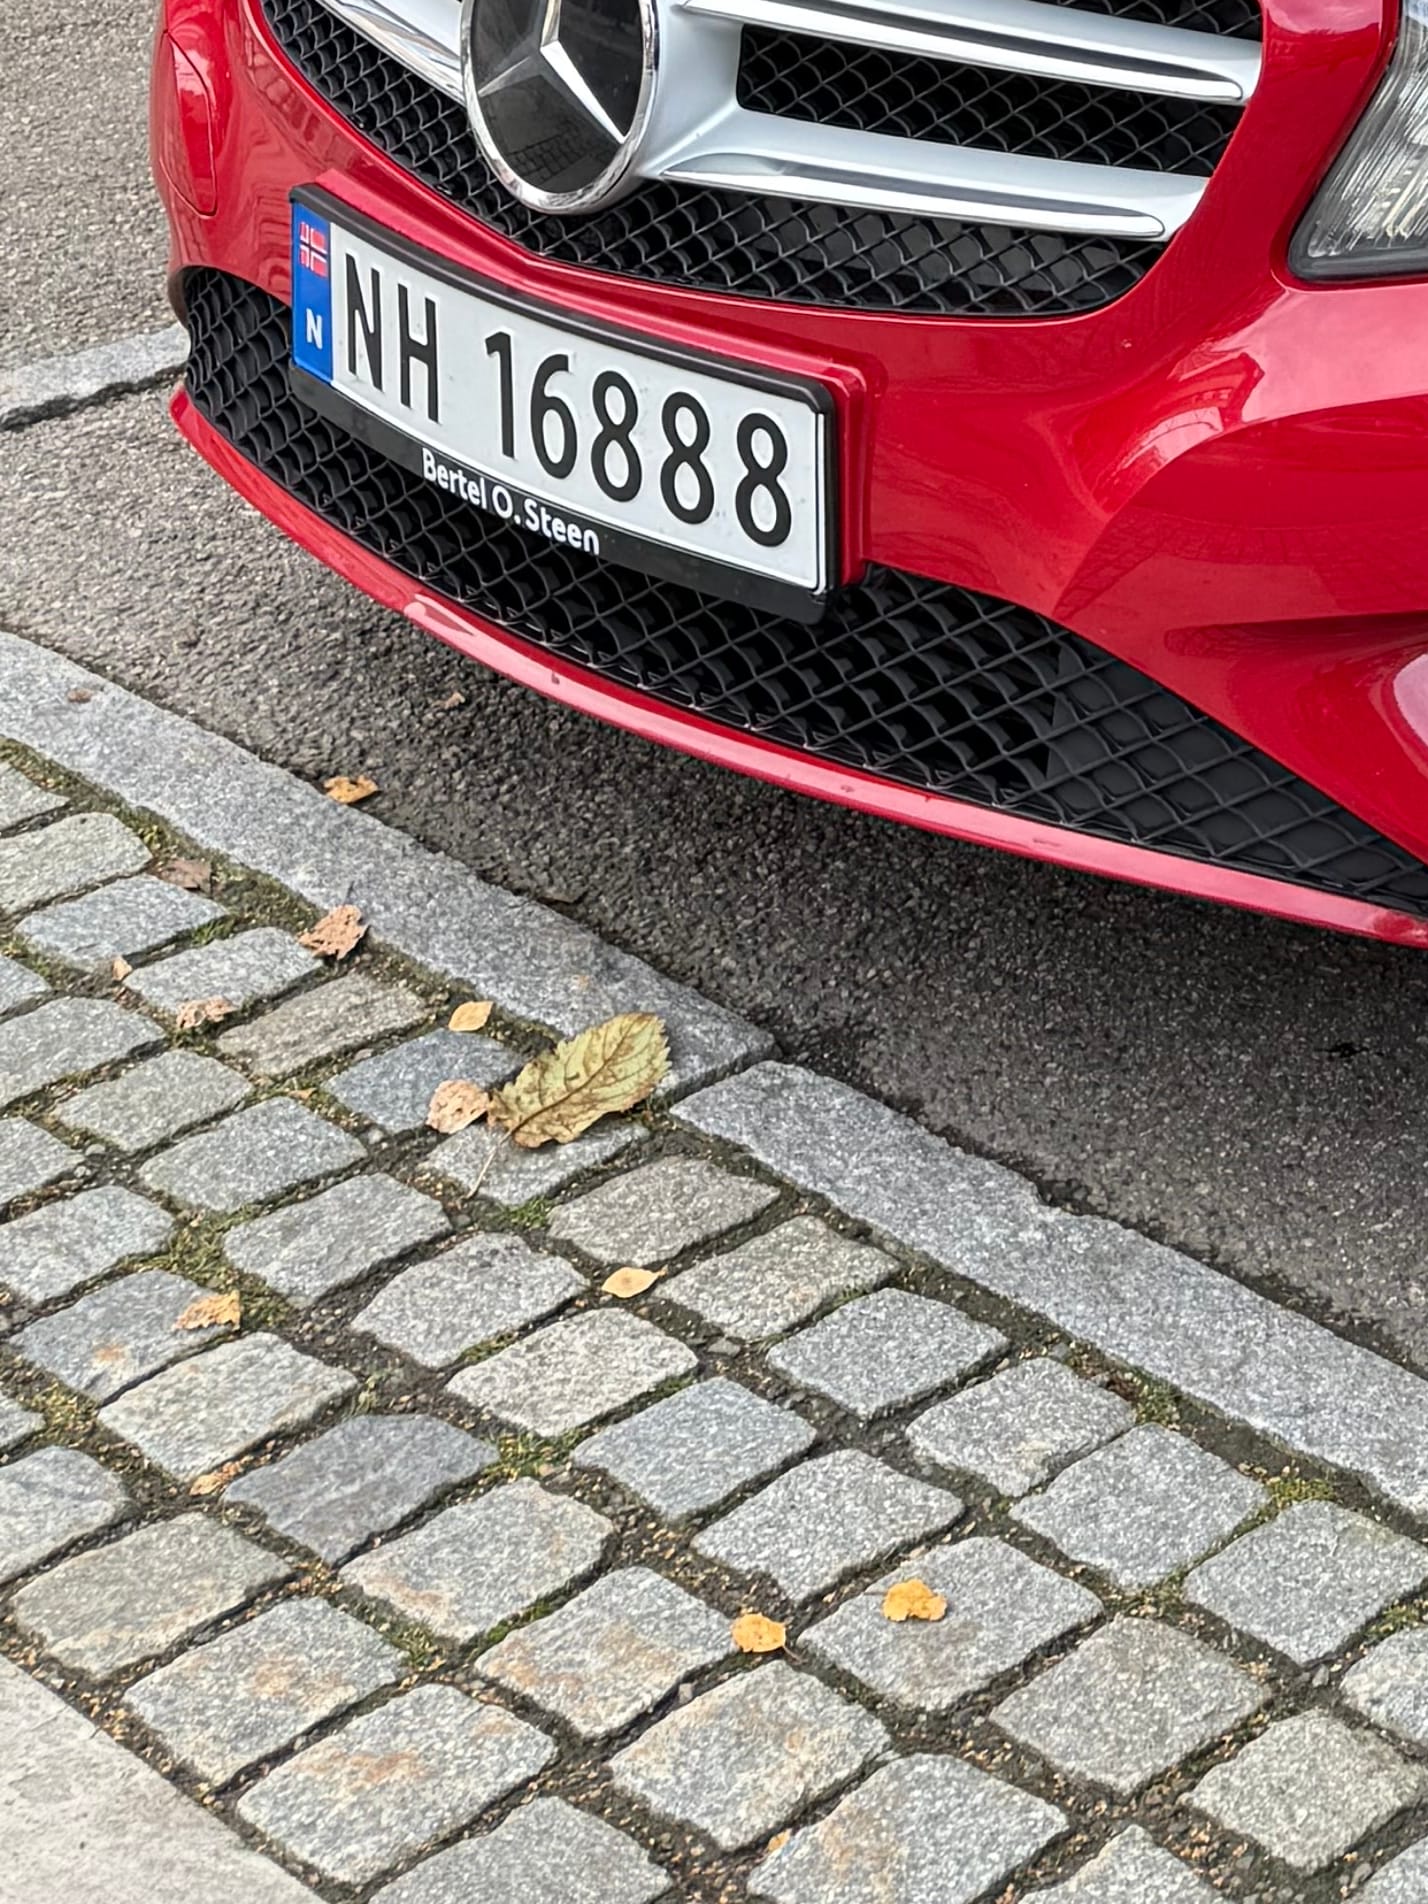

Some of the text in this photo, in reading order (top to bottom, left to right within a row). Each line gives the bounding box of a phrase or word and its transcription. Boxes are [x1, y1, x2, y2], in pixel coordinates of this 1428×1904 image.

[305, 308, 323, 350] N
[345, 253, 792, 547] NH 16888
[422, 447, 487, 510] Bertel
[523, 498, 600, 555] Steen
